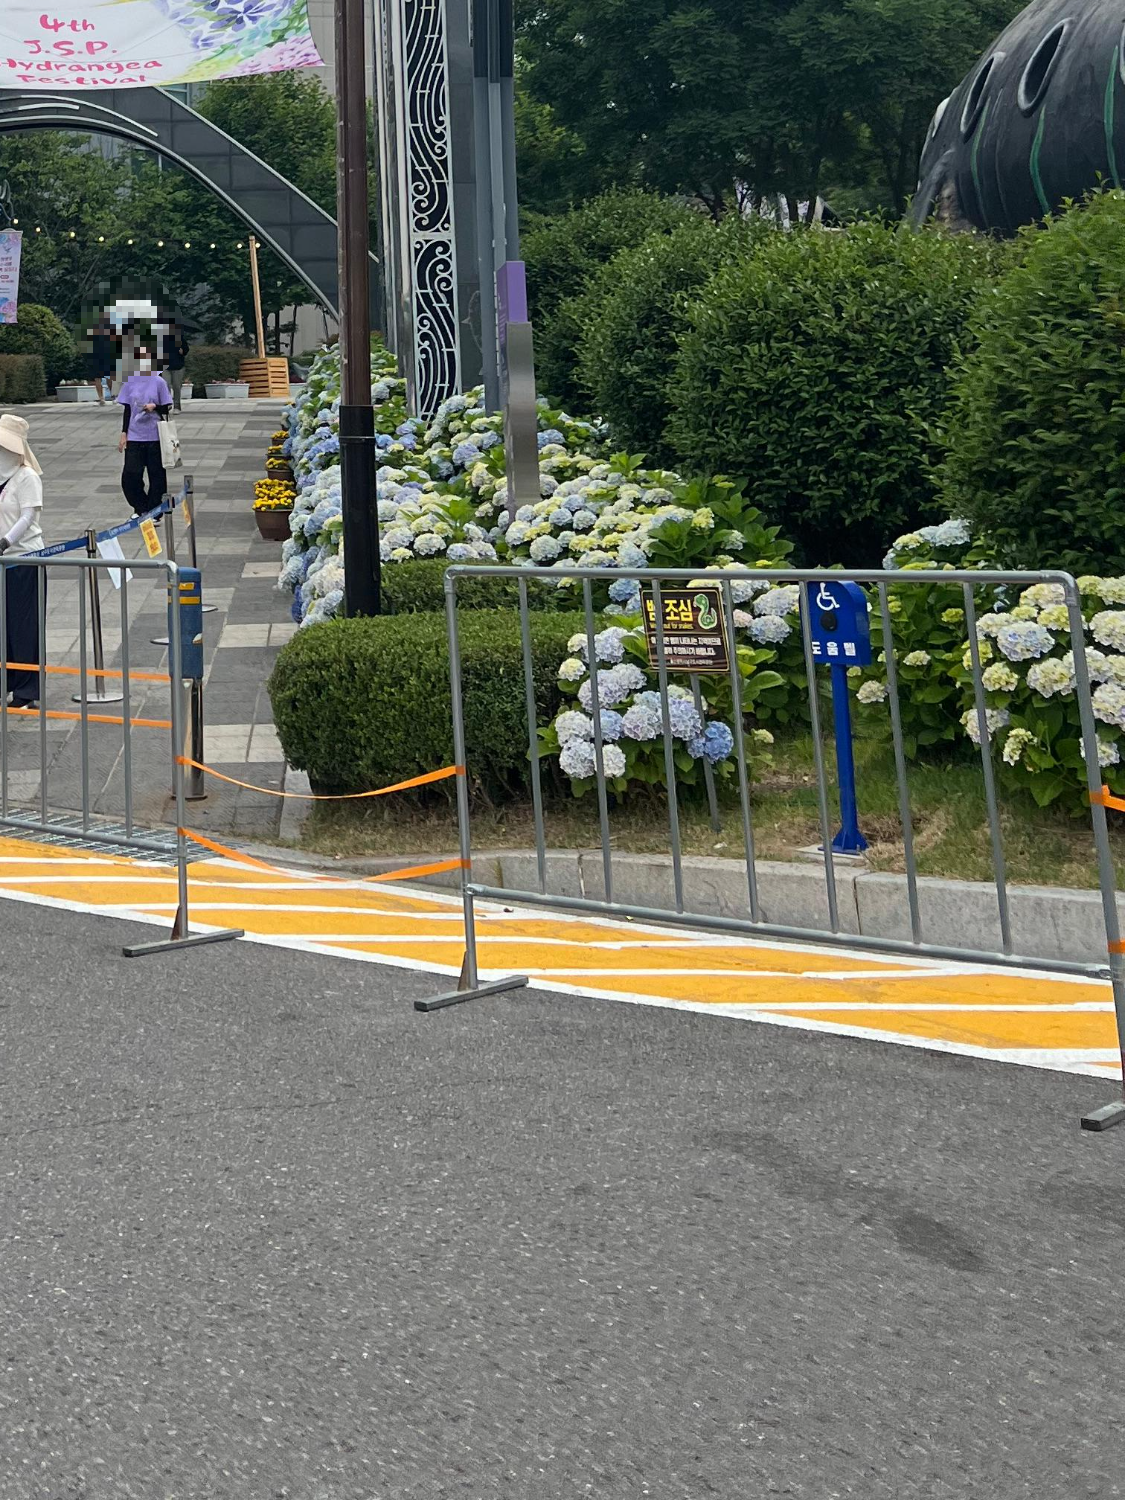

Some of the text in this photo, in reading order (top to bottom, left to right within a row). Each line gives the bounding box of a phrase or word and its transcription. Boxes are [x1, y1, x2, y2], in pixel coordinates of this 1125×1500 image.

[39, 14, 95, 32] 4th
[23, 40, 117, 56] J.S.P.
[16, 74, 147, 86] Festival
[664, 599, 693, 621] 조심
